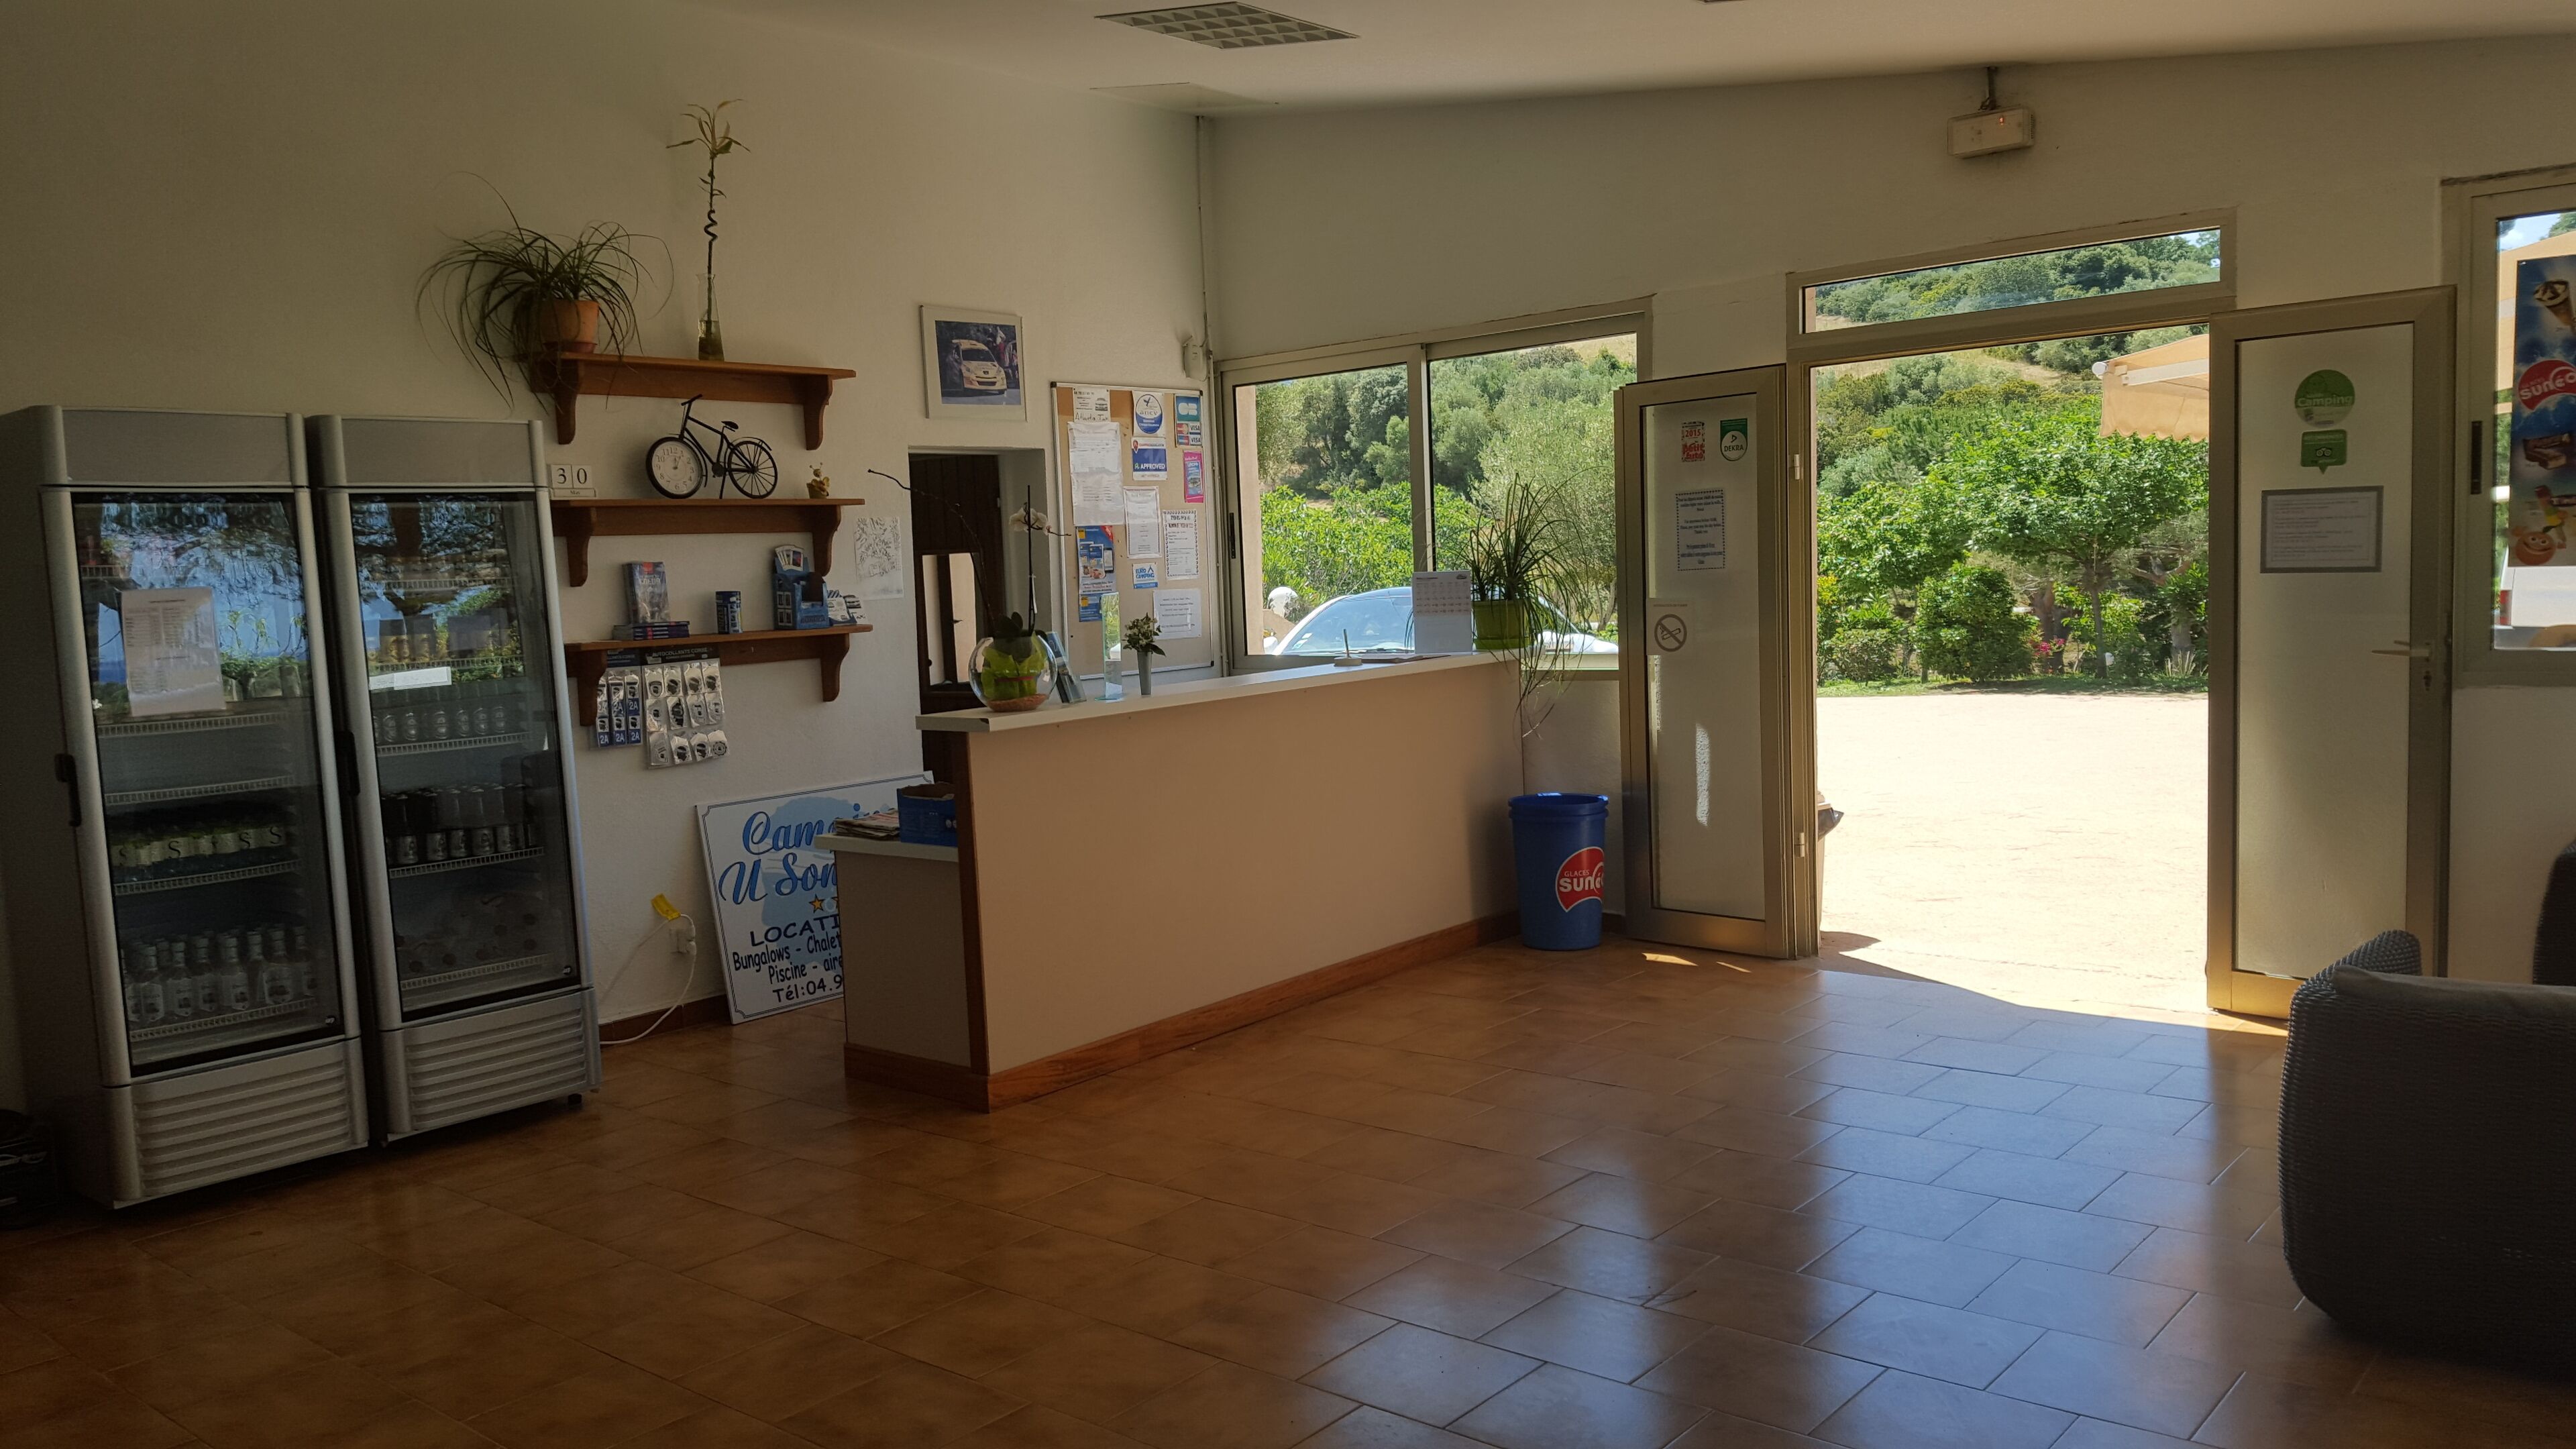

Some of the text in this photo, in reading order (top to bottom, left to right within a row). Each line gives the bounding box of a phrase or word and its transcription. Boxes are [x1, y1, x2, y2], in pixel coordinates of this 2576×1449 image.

[2297, 394, 2354, 408] Camping
[1684, 429, 1701, 437] 2015
[1723, 444, 1744, 452] DEKRA
[652, 649, 690, 657] AUTOCOLLANTS
[613, 702, 623, 711] 2A
[629, 701, 639, 710] 2A
[600, 735, 609, 744] 2A
[616, 733, 625, 743] 2A
[631, 731, 640, 741] 2A
[718, 858, 768, 905] U
[732, 943, 791, 972] Bungalows
[768, 963, 807, 984] Piscine
